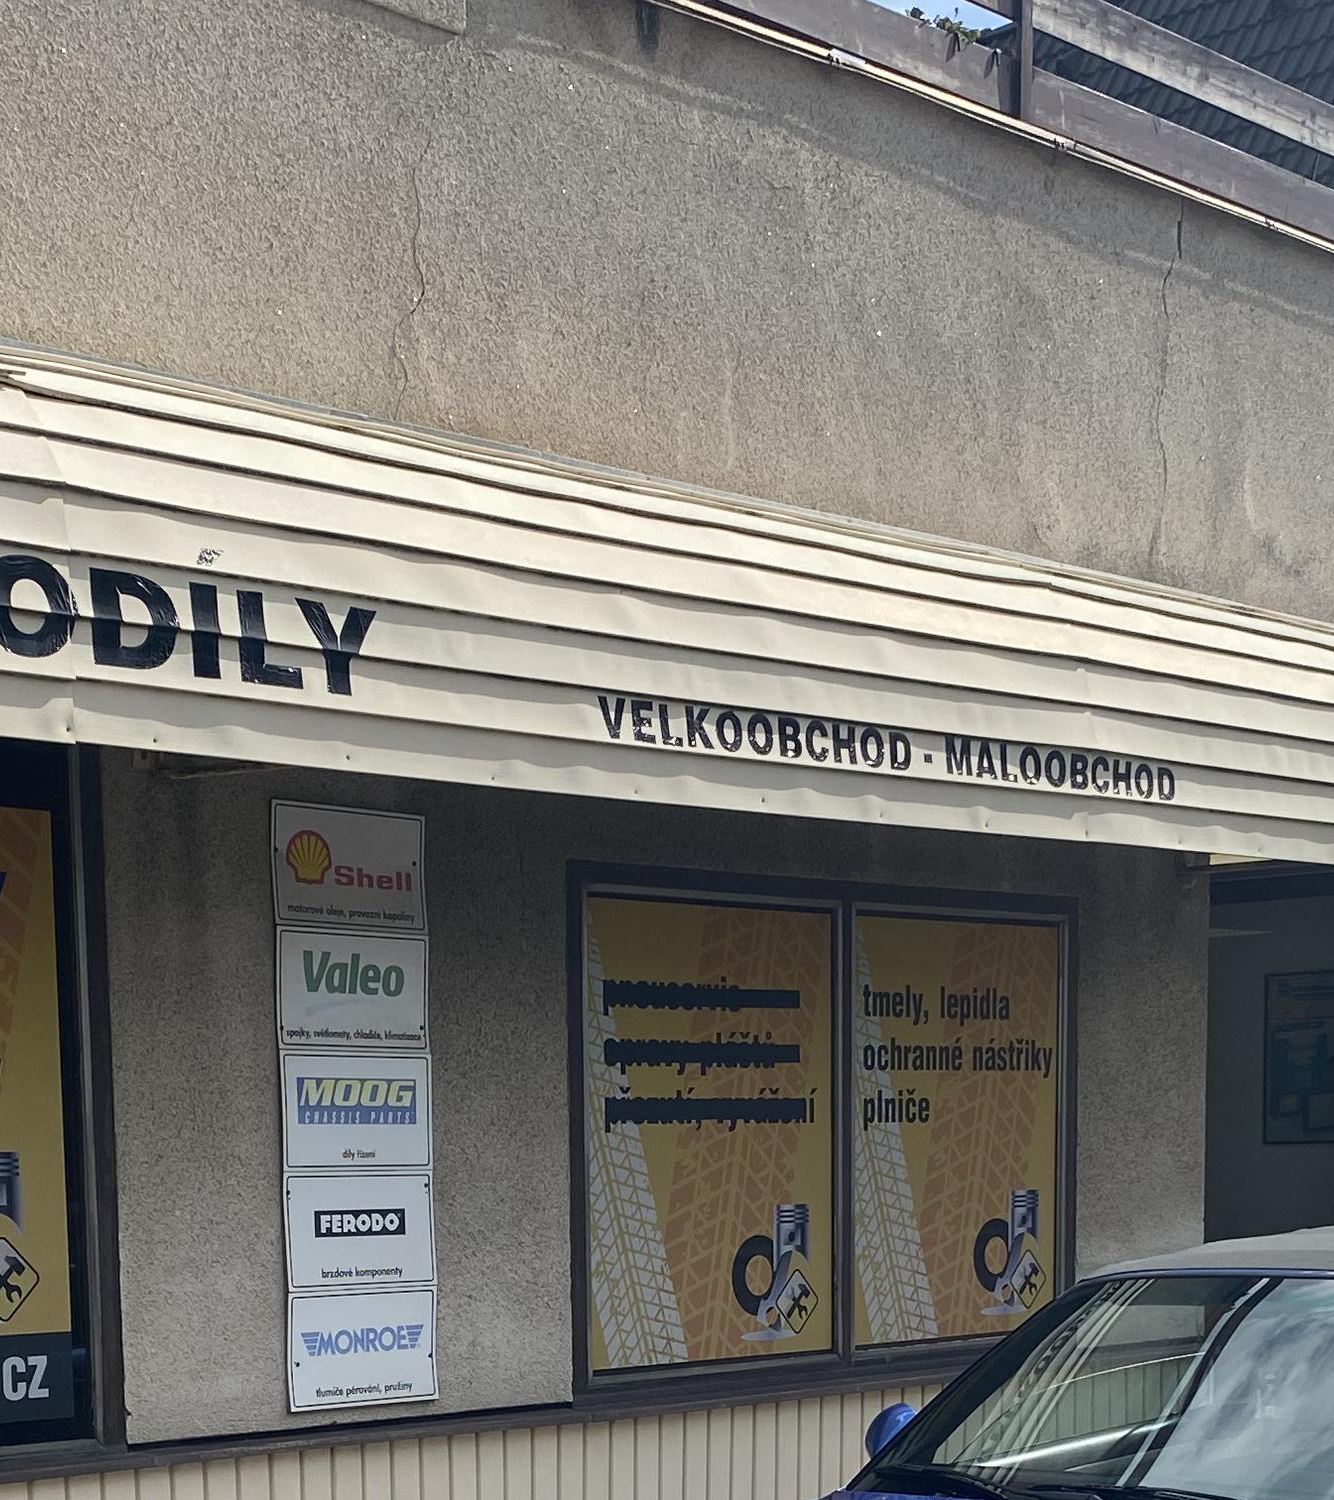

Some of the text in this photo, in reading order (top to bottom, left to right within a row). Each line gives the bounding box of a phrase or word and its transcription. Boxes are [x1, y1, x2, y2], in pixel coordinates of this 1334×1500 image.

[597, 695, 1175, 801] VELKOOBCHOD MALOOBCHOD
[334, 865, 412, 892] Shell
[302, 950, 405, 997] Valeo
[863, 984, 1010, 1025] tmely, lepidla
[863, 1037, 1053, 1079] ochranné nástřiky
[299, 1079, 414, 1107] MOOG
[863, 1088, 930, 1131] plniče
[304, 1111, 411, 1124] CHASSIS PARTS
[319, 1212, 400, 1234] FERODO
[317, 1325, 410, 1356] MONROE
